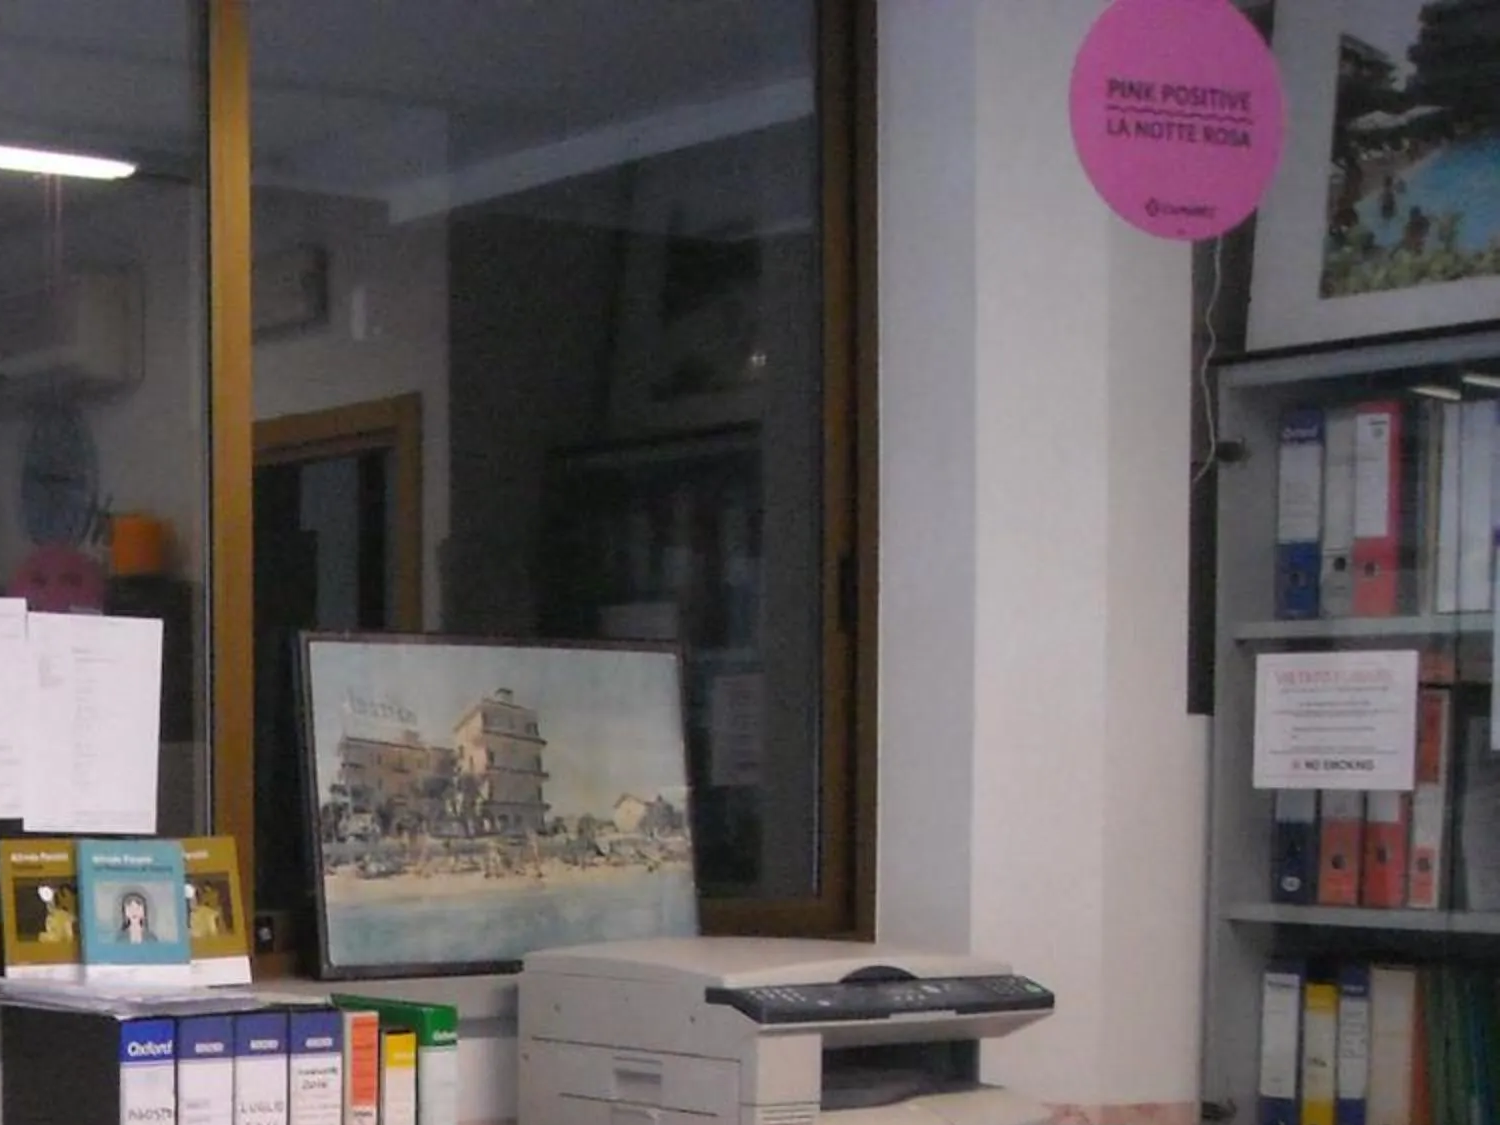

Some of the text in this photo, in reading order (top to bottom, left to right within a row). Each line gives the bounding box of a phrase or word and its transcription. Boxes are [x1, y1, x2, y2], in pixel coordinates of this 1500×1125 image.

[1107, 78, 1252, 112] PINK POSITIVE
[1106, 118, 1252, 149] LA NOTTE ROSA
[127, 1040, 173, 1057] Oxford
